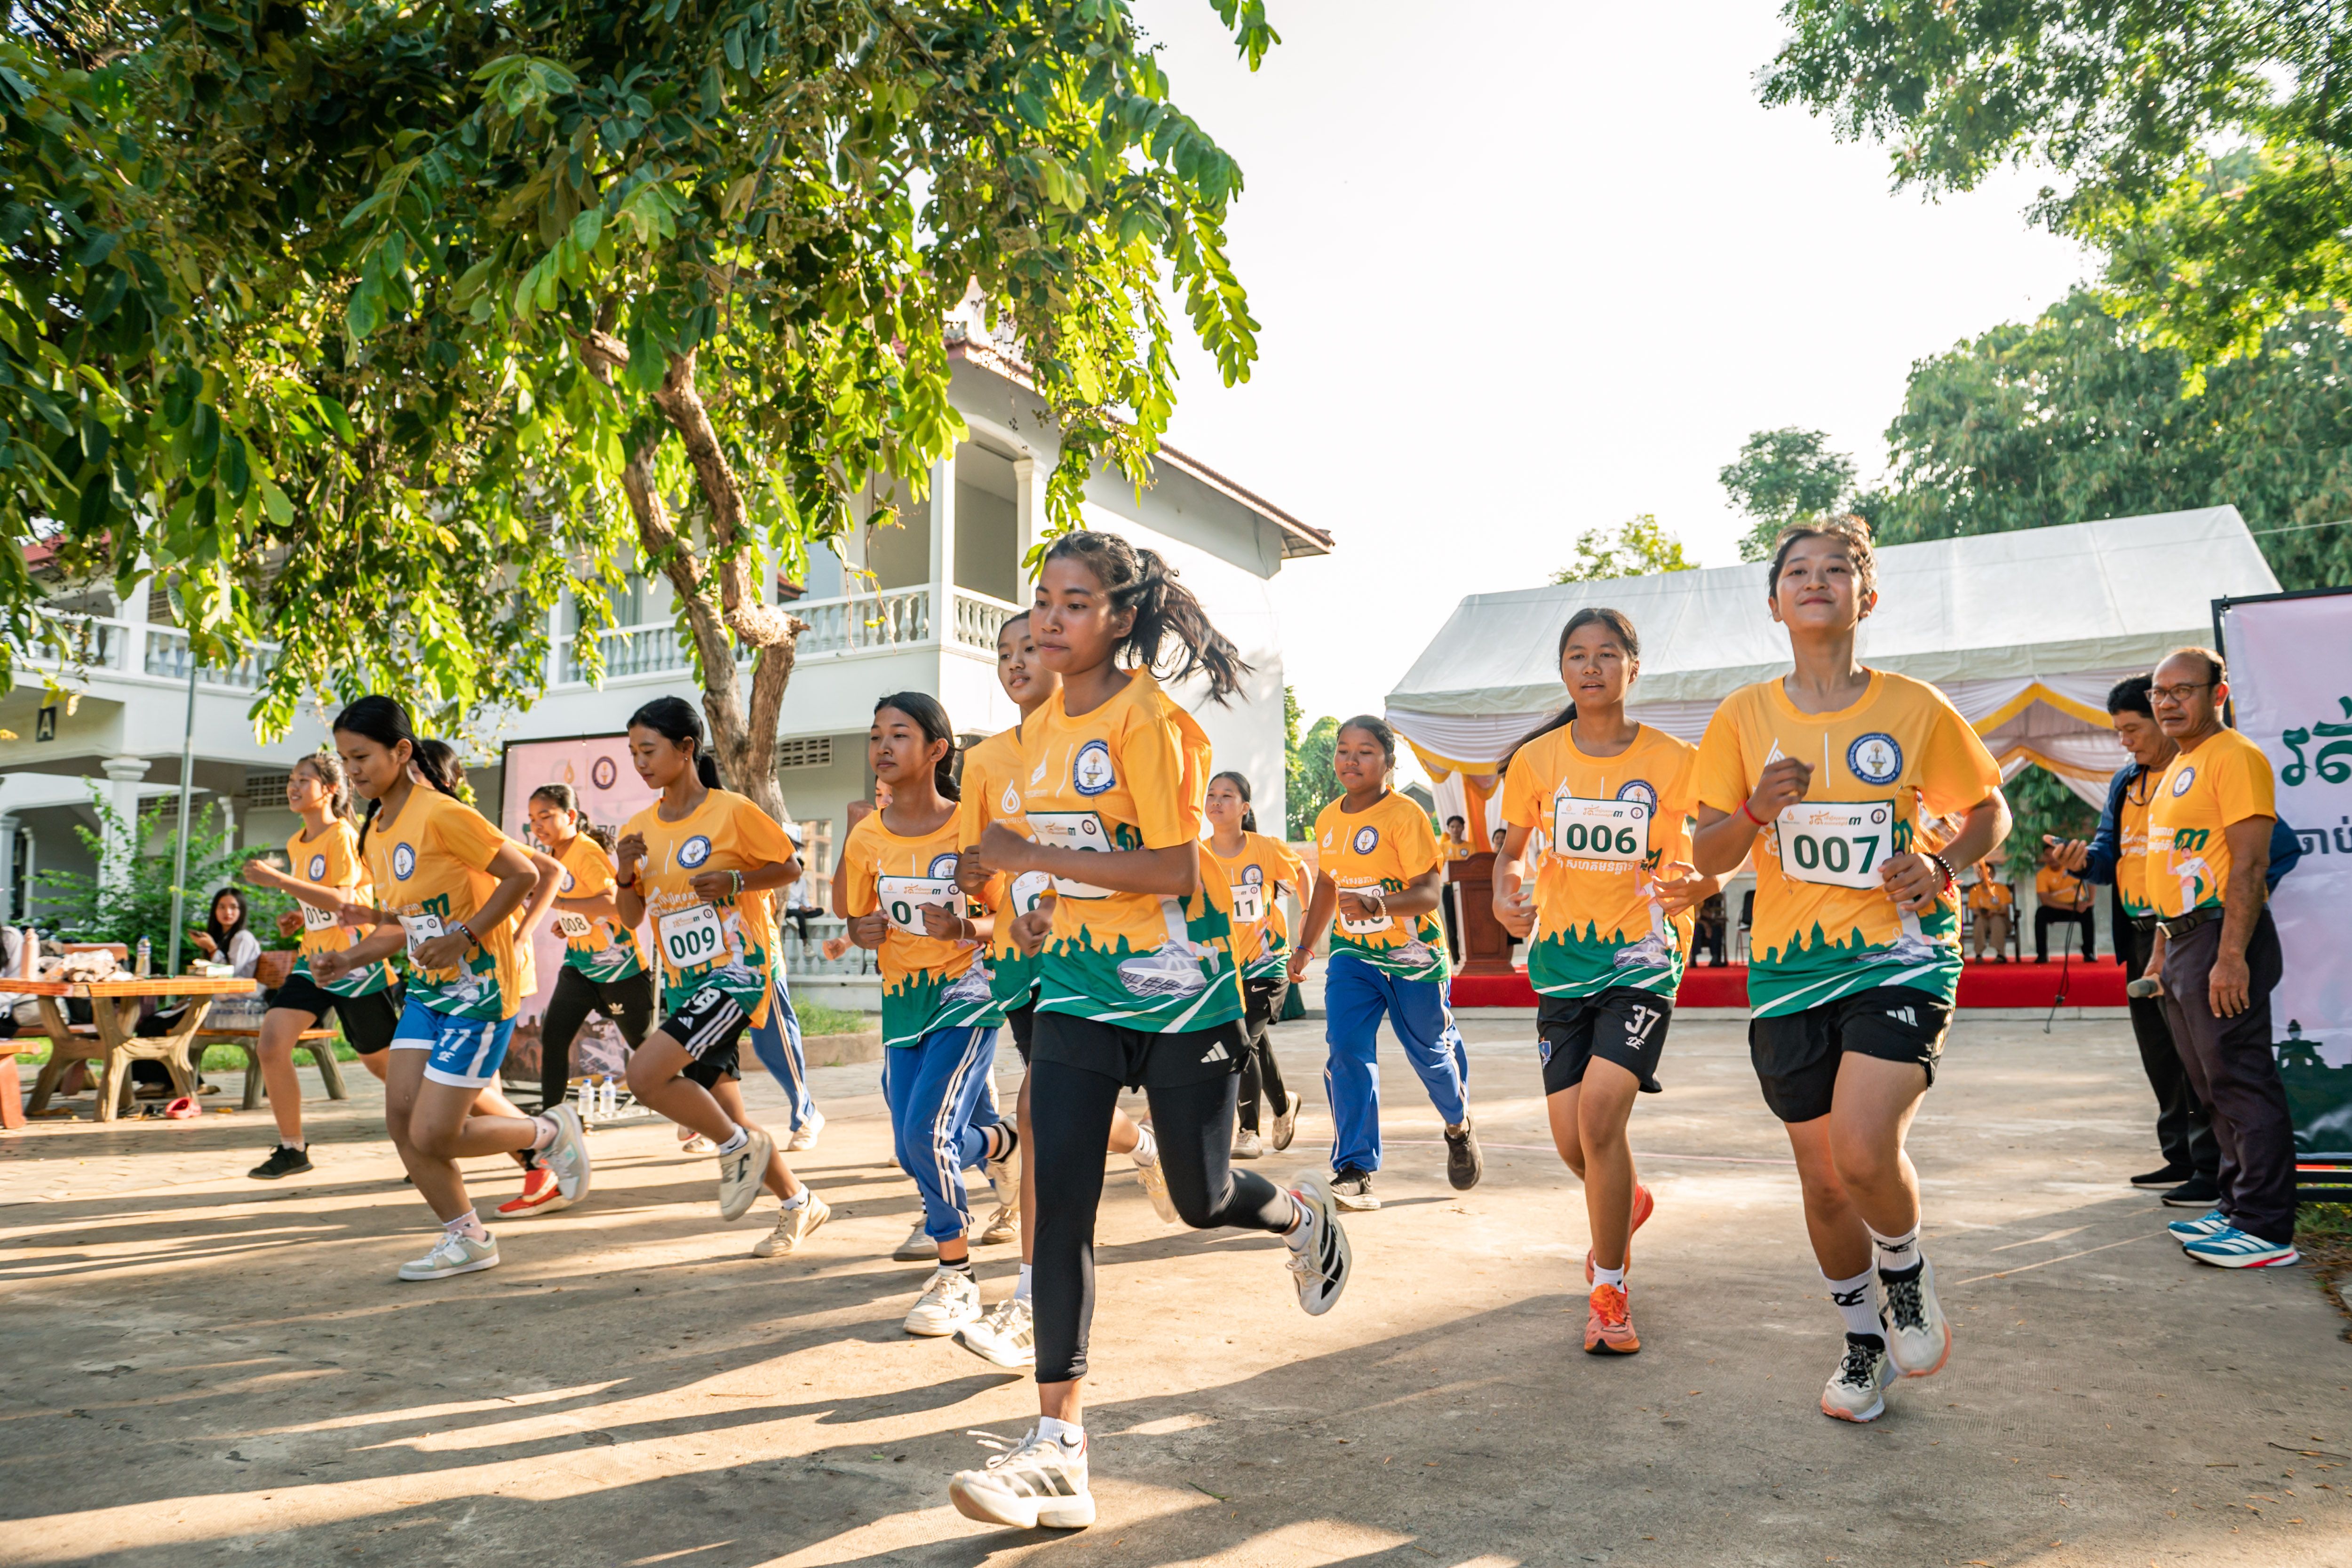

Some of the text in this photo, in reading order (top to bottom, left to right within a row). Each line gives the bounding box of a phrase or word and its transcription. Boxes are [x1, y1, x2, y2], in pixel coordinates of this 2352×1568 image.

[38, 711, 54, 738] A
[1566, 823, 1637, 854] 006
[1794, 835, 1880, 874] 007
[1234, 899, 1254, 916] 11
[561, 917, 587, 931] 008
[670, 926, 715, 959] 009
[1625, 1004, 1661, 1040] 37
